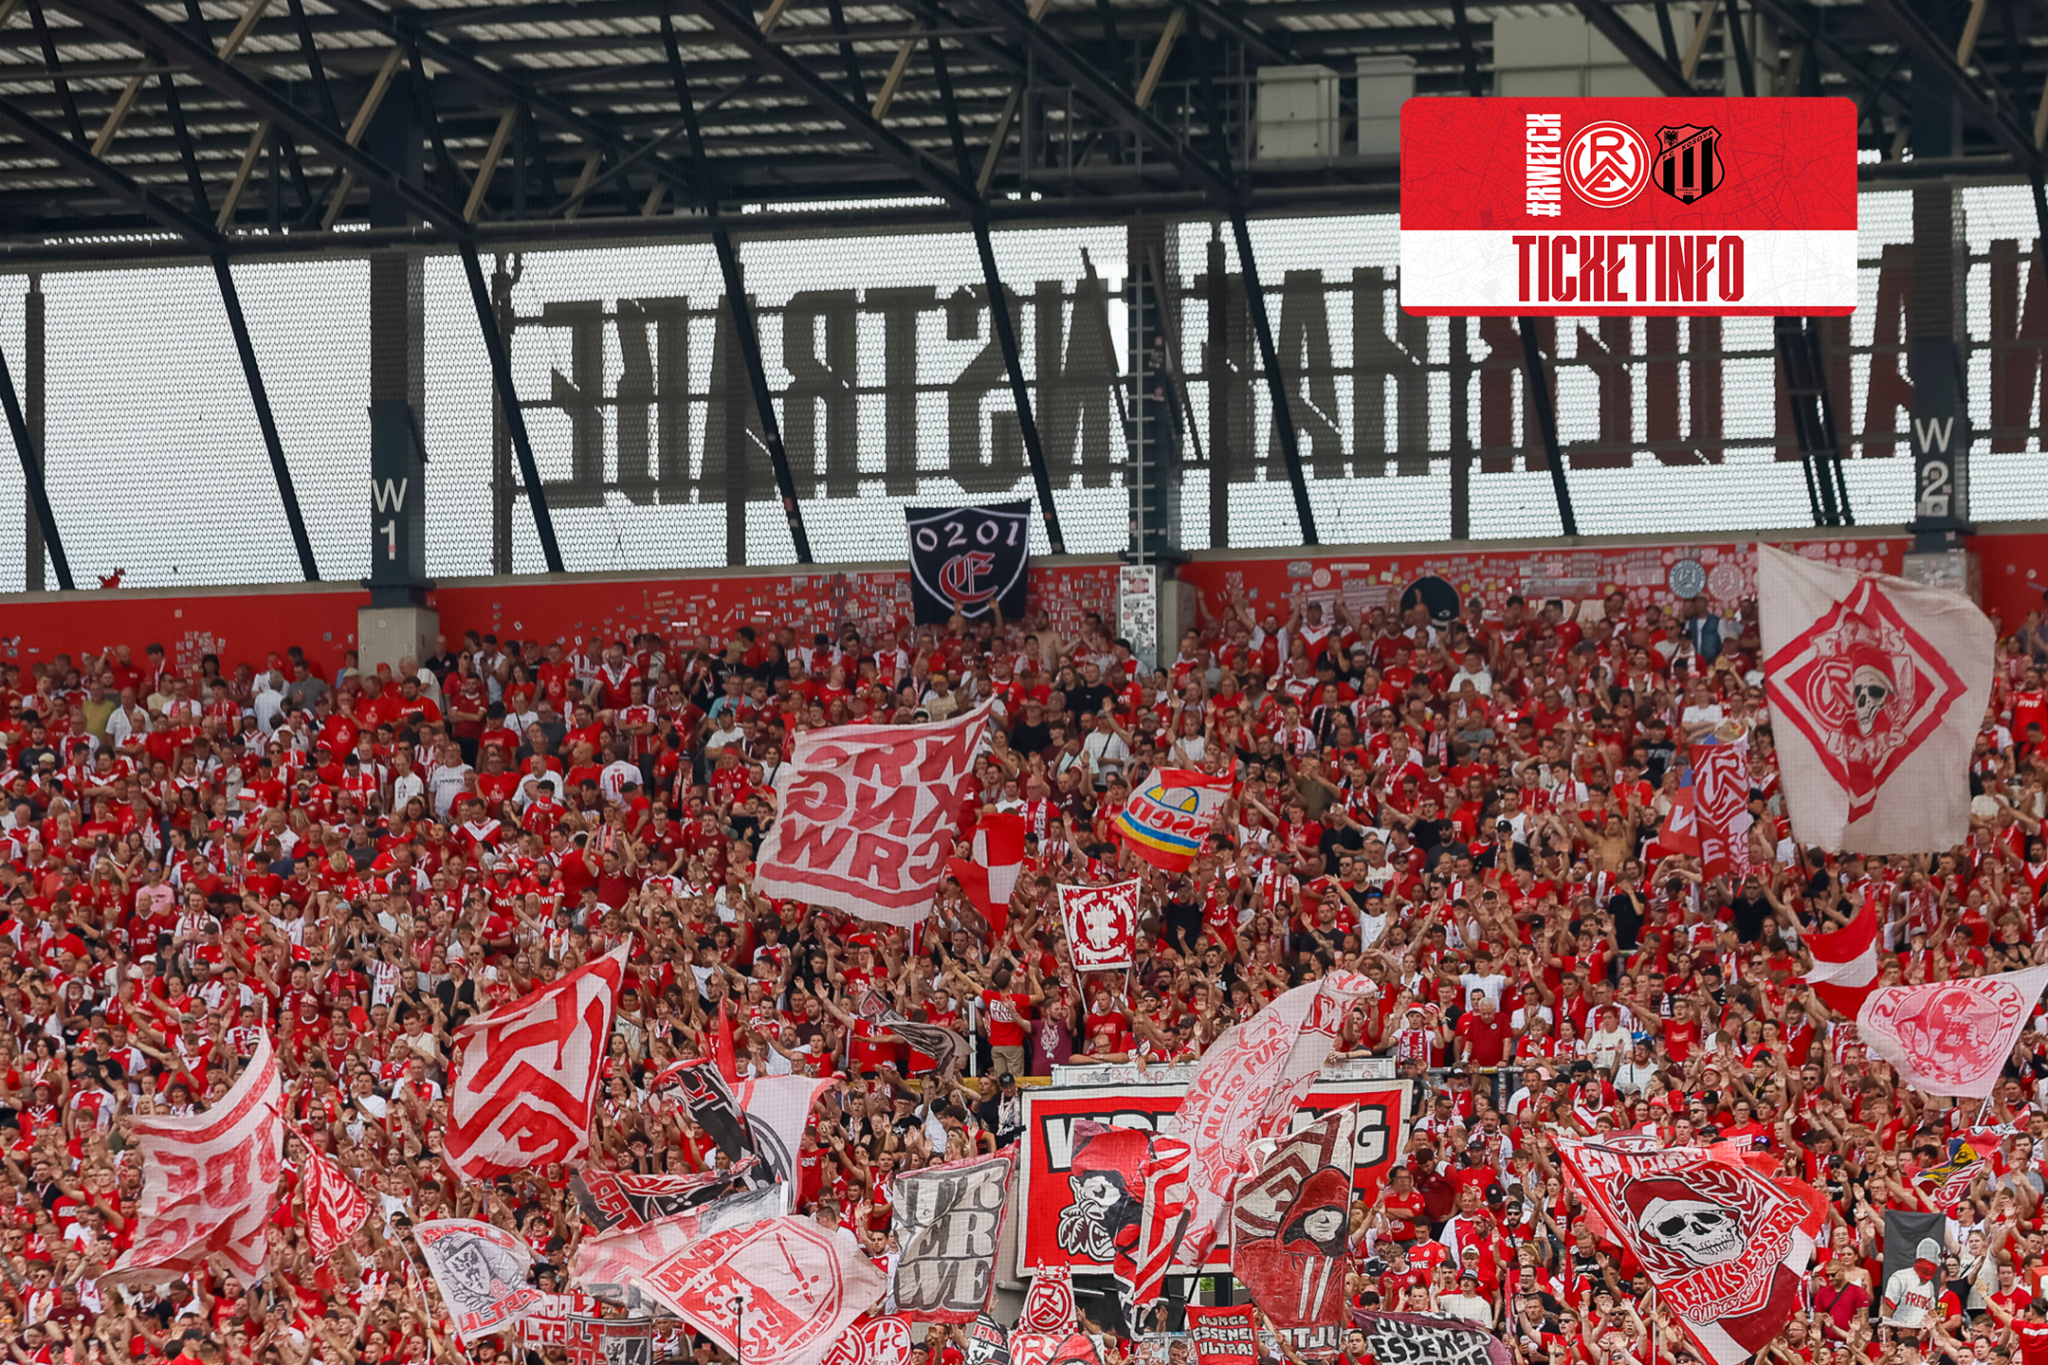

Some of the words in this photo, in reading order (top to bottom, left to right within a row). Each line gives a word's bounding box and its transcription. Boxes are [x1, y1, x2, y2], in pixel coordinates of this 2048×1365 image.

[1915, 416, 1954, 453] W
[371, 478, 408, 513] W
[1921, 461, 1949, 505] 2
[380, 520, 396, 560] 1
[916, 520, 1019, 552] 0201
[1659, 1260, 1747, 1316] REAKS
[1736, 1198, 1812, 1273] ESSEN
[1756, 1234, 1793, 1278] 2015
